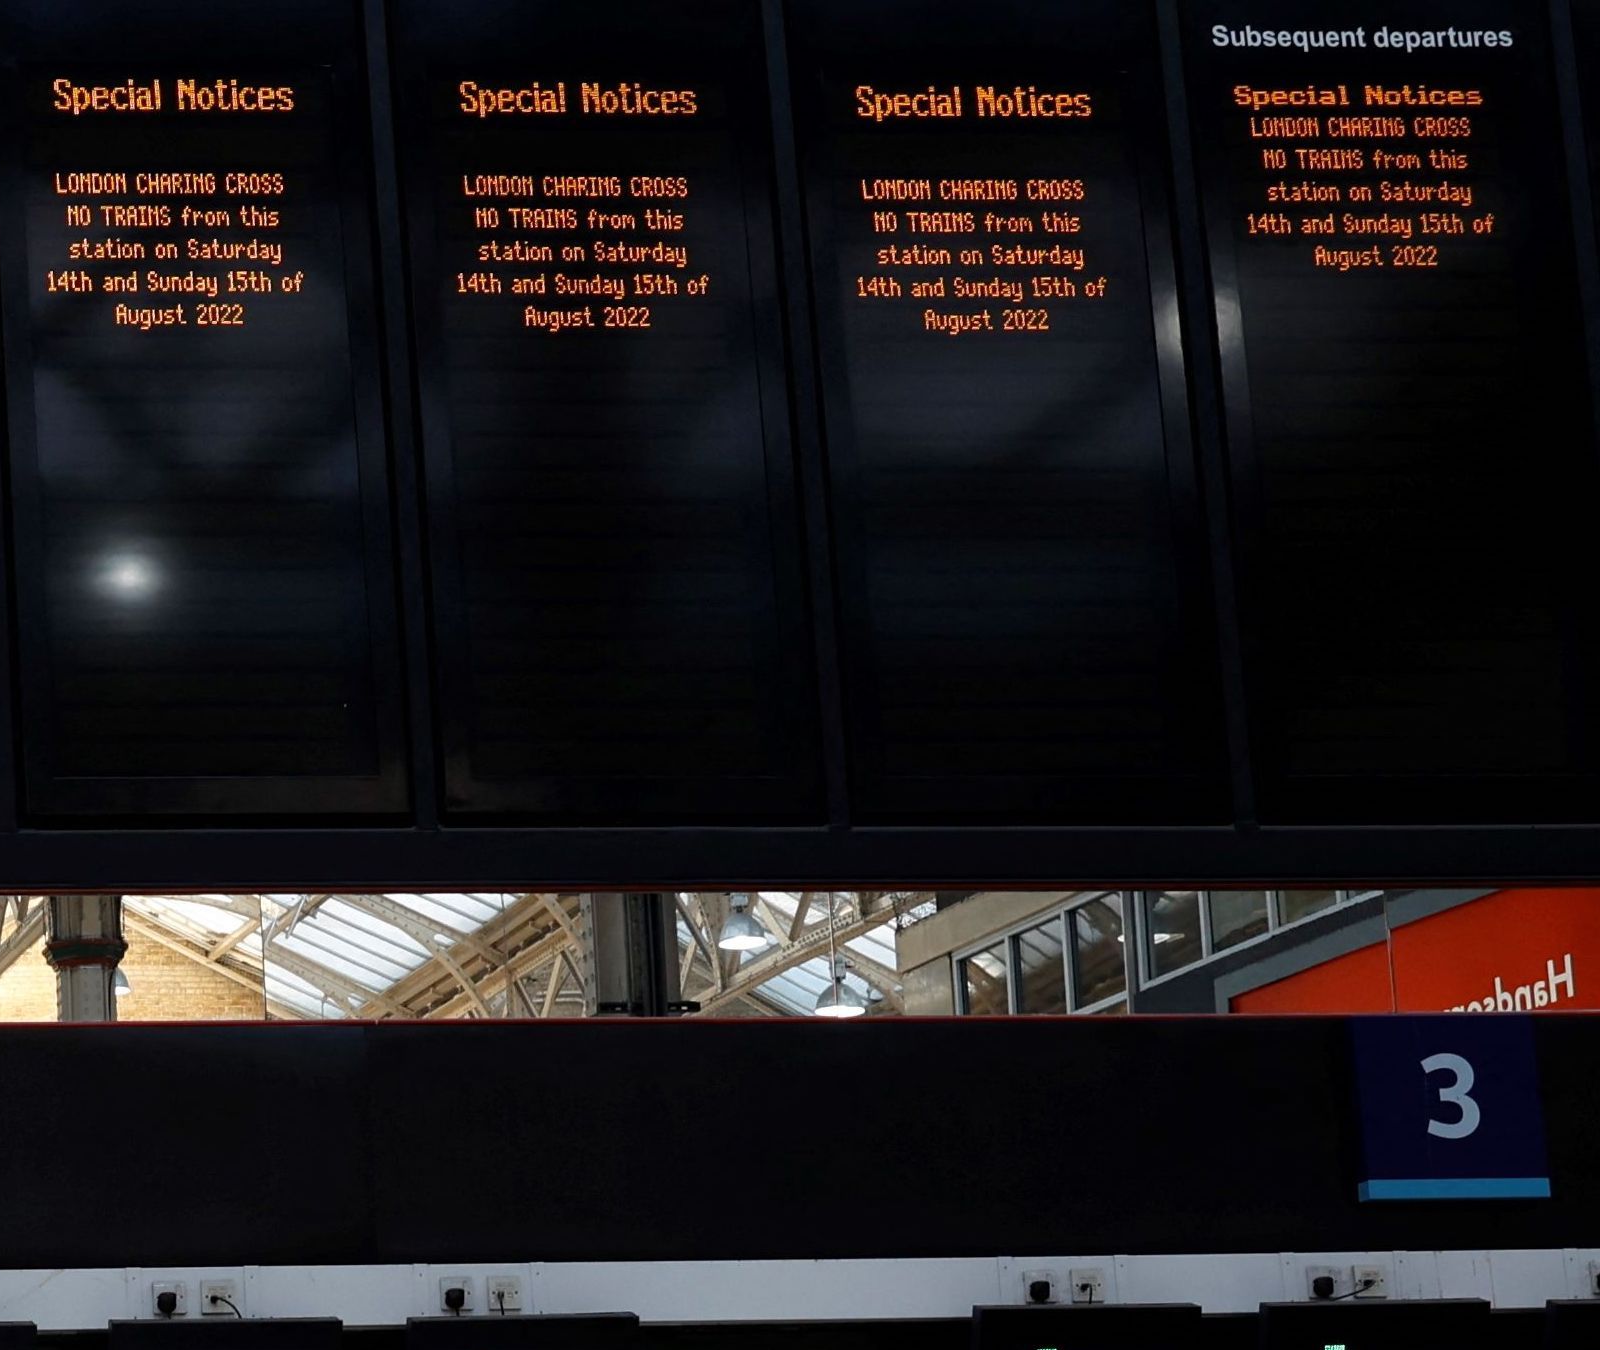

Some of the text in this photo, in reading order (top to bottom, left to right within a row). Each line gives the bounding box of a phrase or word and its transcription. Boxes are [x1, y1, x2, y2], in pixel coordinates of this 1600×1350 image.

[1212, 25, 1513, 53] Subsequent departures
[1233, 84, 1484, 111] Special Notices
[1250, 116, 1471, 138] LONDON CHARING CROSS
[1263, 148, 1468, 170] NO TRAINS from this
[1267, 181, 1472, 207] station on Saturday
[1247, 213, 1494, 239] 14th and Sunday 15th of
[1314, 245, 1438, 272] August 2022
[1421, 1053, 1480, 1139] 3
